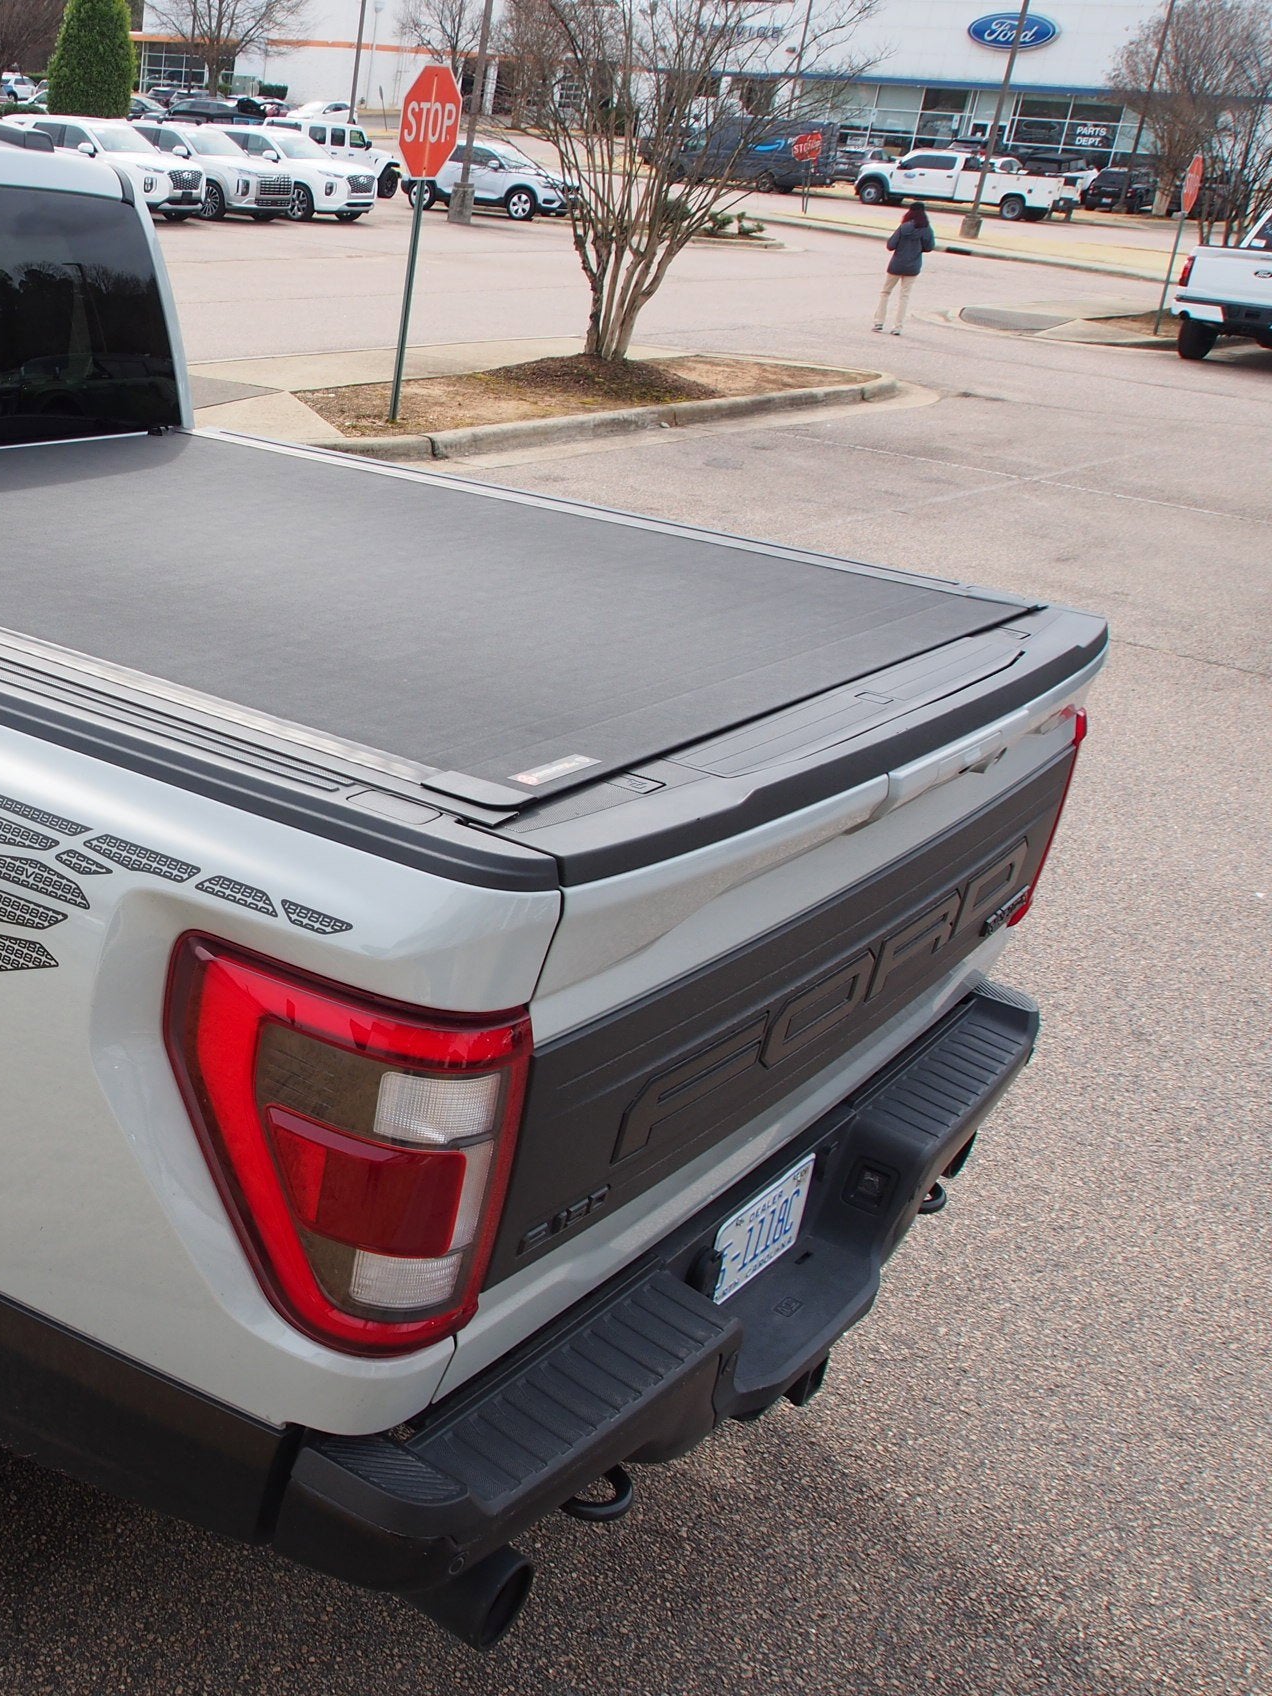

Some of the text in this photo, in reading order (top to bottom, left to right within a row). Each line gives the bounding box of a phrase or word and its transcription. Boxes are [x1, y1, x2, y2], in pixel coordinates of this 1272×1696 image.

[984, 19, 1039, 42] Ford
[404, 101, 456, 143] STOP
[1076, 126, 1107, 136] PARTS
[1074, 137, 1103, 147] DEPT.
[610, 836, 1028, 1165] FORD
[749, 1189, 784, 1223] DEALER
